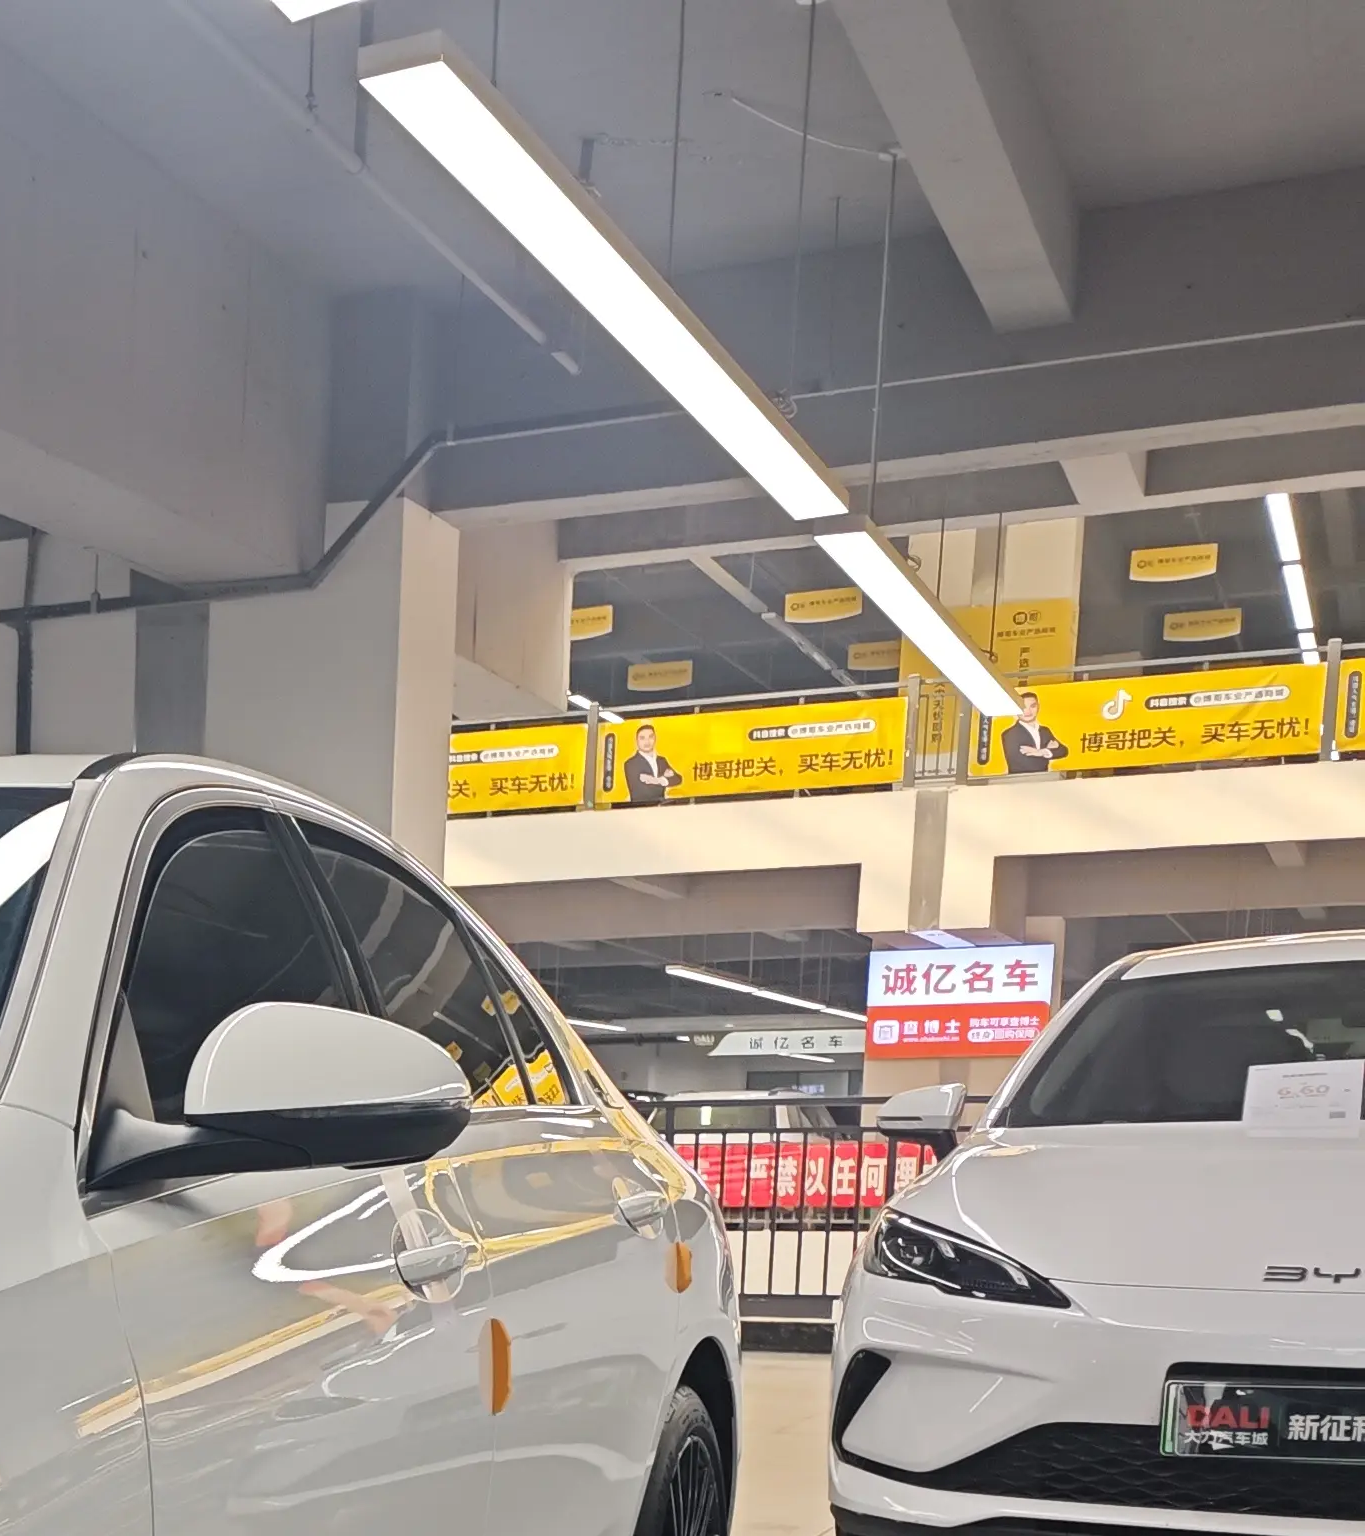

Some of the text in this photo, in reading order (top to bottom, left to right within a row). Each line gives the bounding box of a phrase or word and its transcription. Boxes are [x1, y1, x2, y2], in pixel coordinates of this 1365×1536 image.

[448, 772, 575, 800] 关，买车无忧！
[881, 959, 1039, 996] 诚亿名车
[1185, 1404, 1270, 1429] DALI
